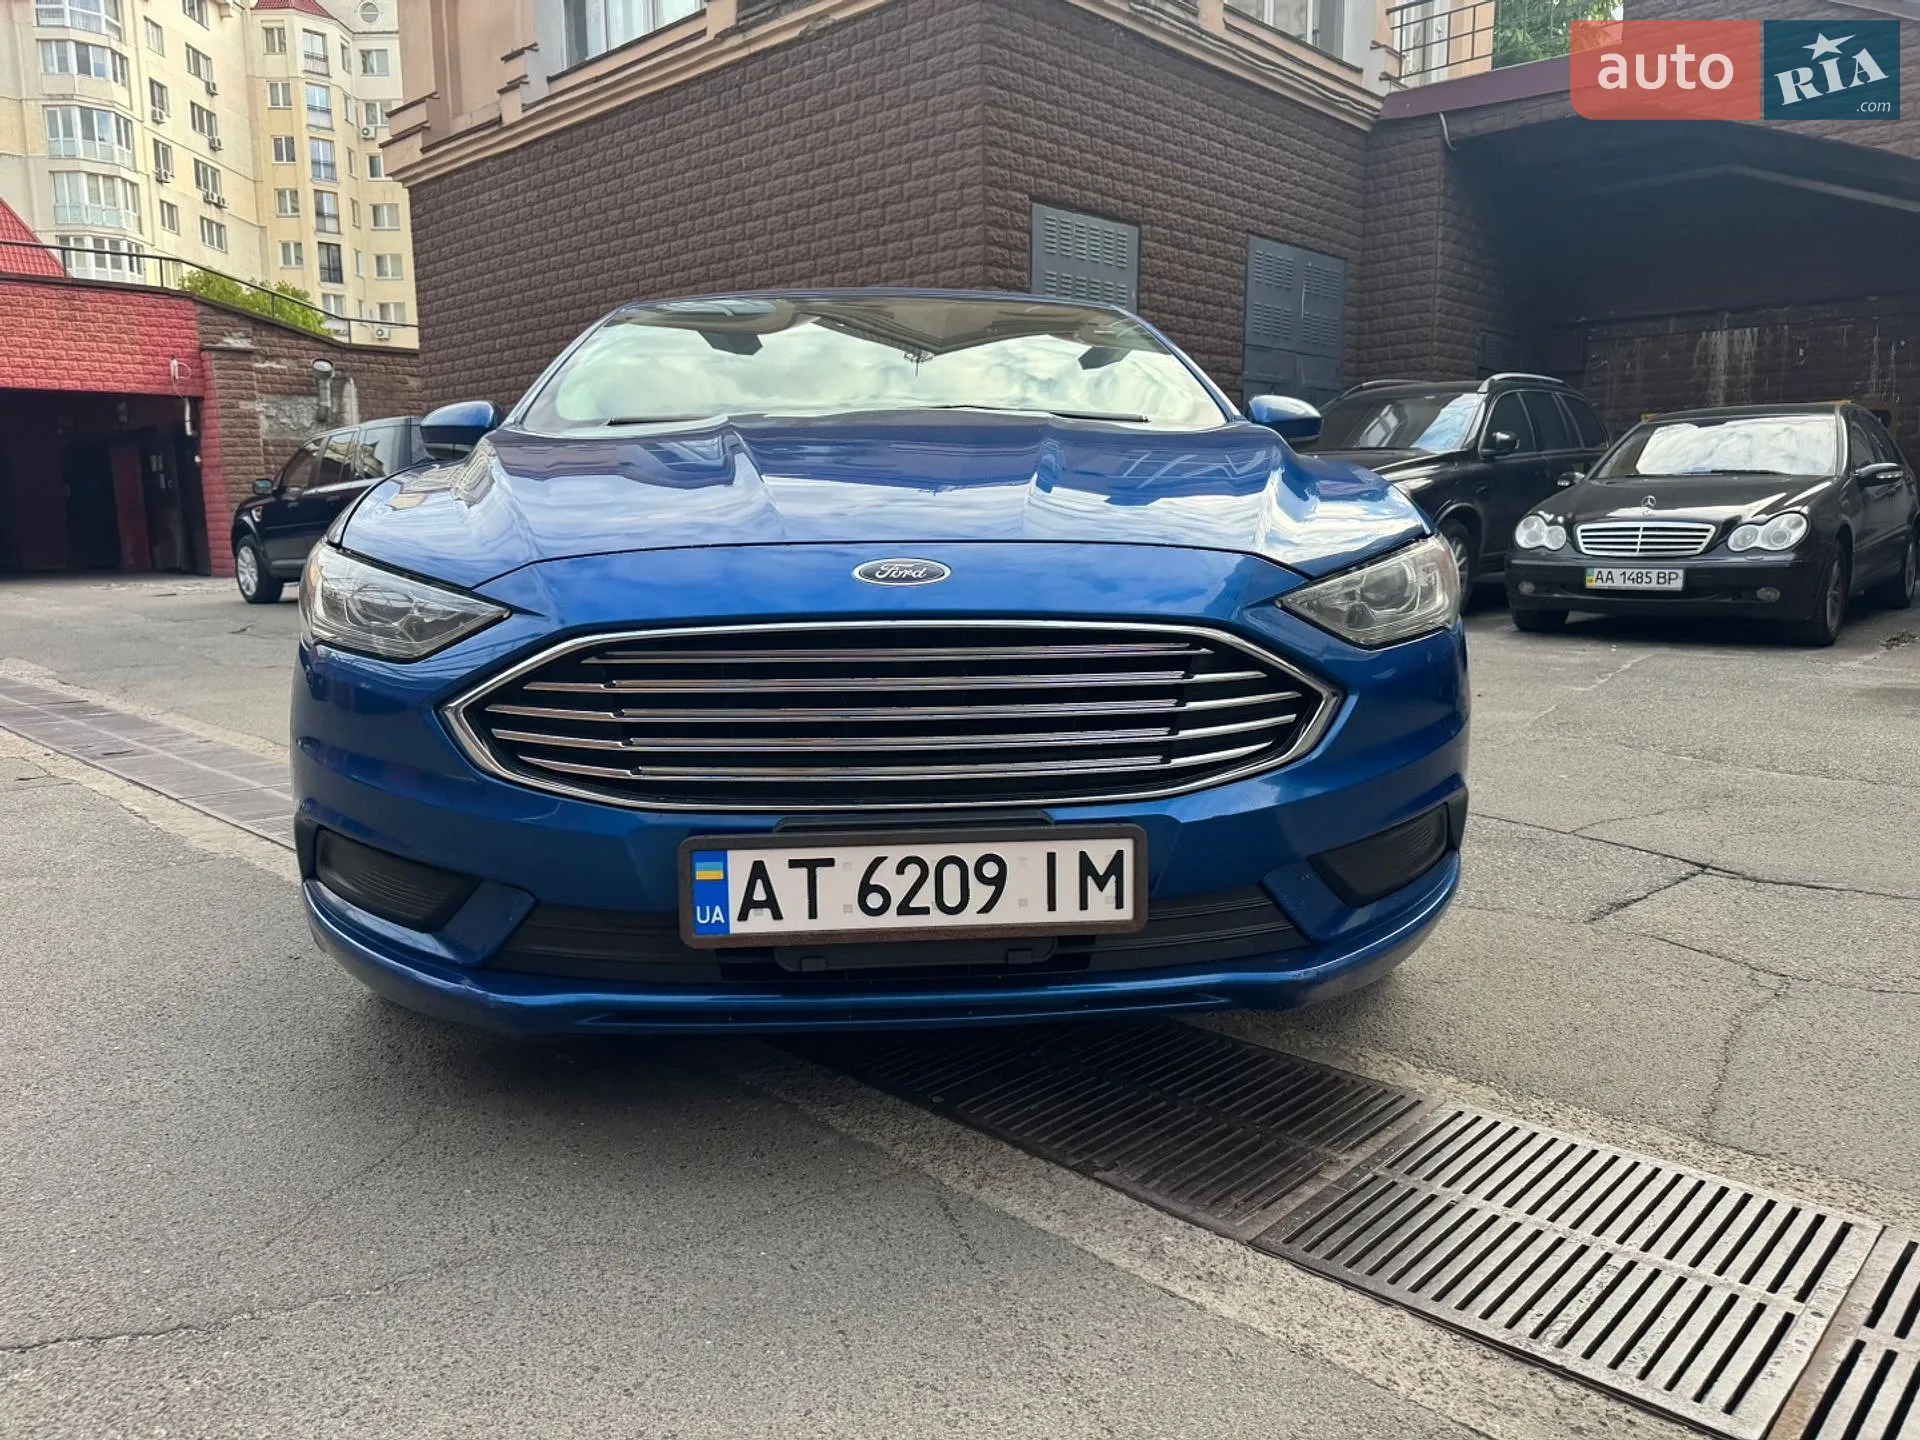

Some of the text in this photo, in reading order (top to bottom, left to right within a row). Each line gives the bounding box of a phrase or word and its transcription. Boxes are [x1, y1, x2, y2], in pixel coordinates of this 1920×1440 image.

[875, 564, 927, 578] Ford
[1595, 570, 1615, 584] AA
[1620, 572, 1652, 584] 1485
[1656, 571, 1680, 585] BP
[737, 849, 1125, 921] AT 6209 IM
[696, 905, 725, 924] UA
